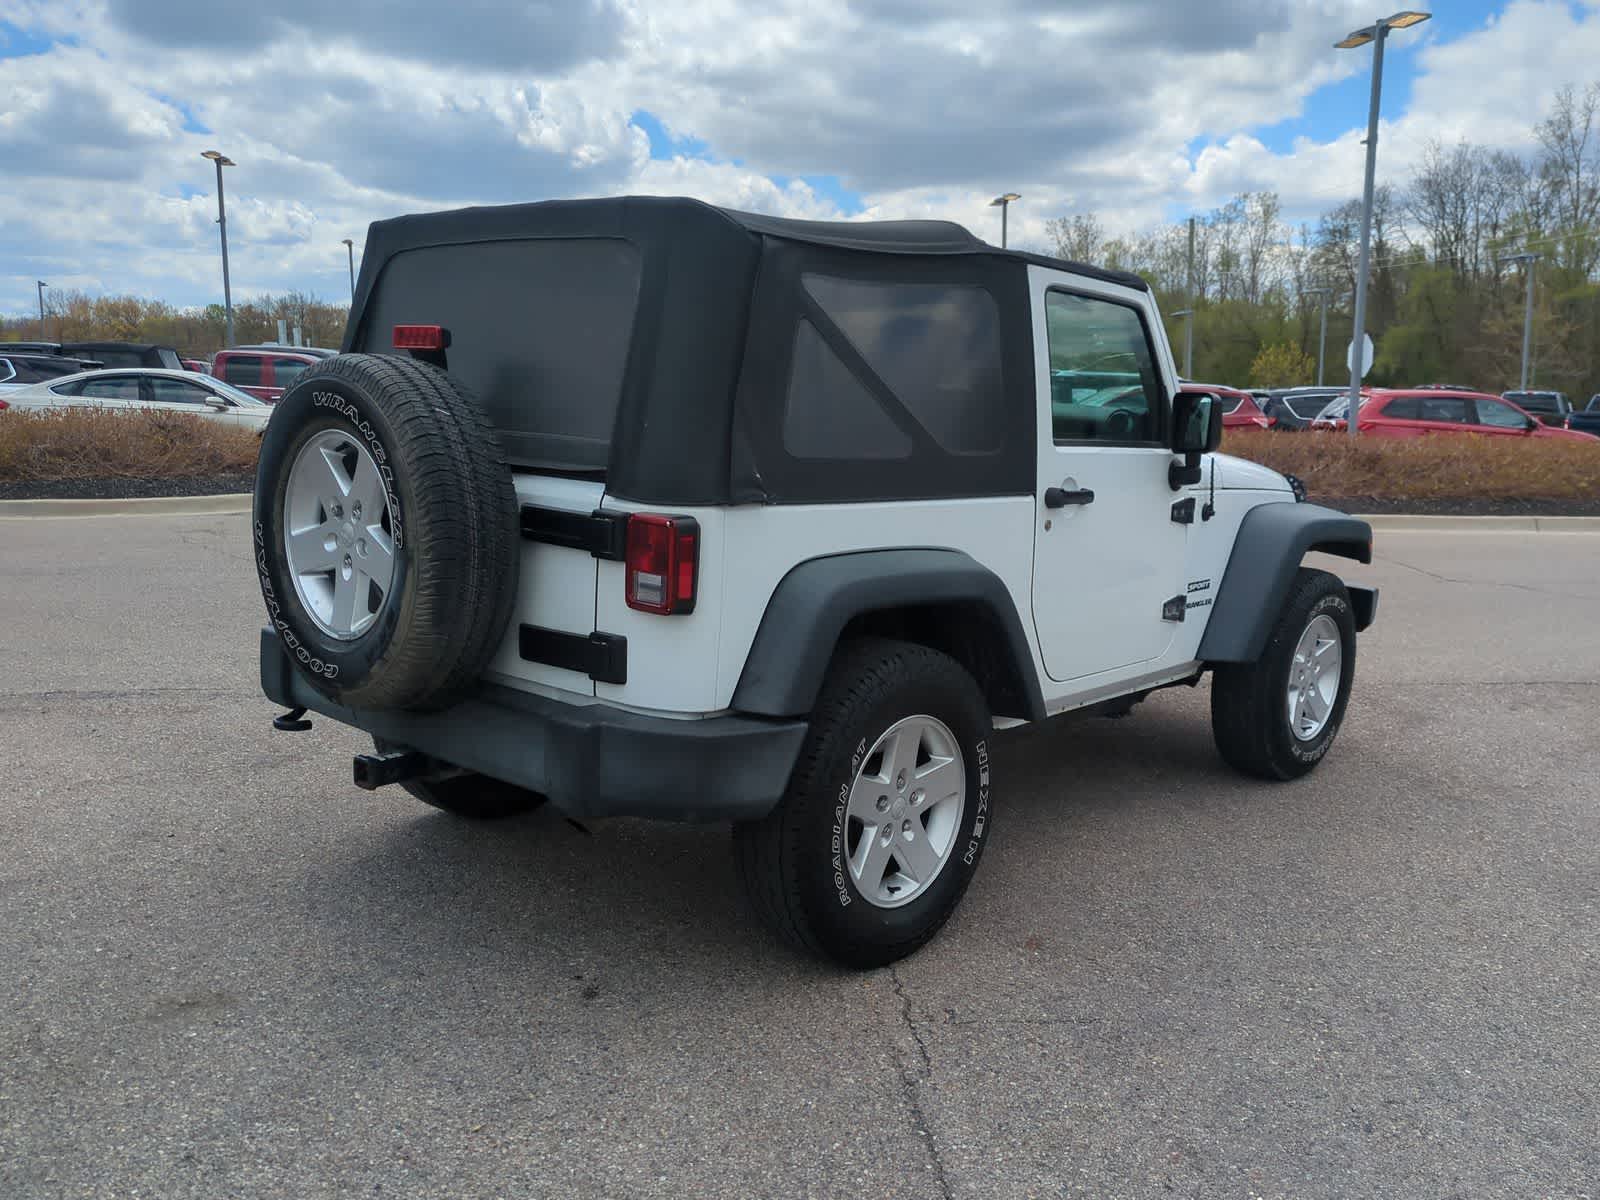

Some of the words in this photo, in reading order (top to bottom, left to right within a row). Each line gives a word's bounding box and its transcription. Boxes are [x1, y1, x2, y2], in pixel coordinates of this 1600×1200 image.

[312, 391, 404, 549] WRANGLER
[254, 519, 339, 679] GOODYEAR
[1184, 598, 1212, 609] RANGLER
[1187, 579, 1211, 593] SPORT
[832, 784, 851, 906] ROADIAN
[964, 740, 989, 865] NEXEN
